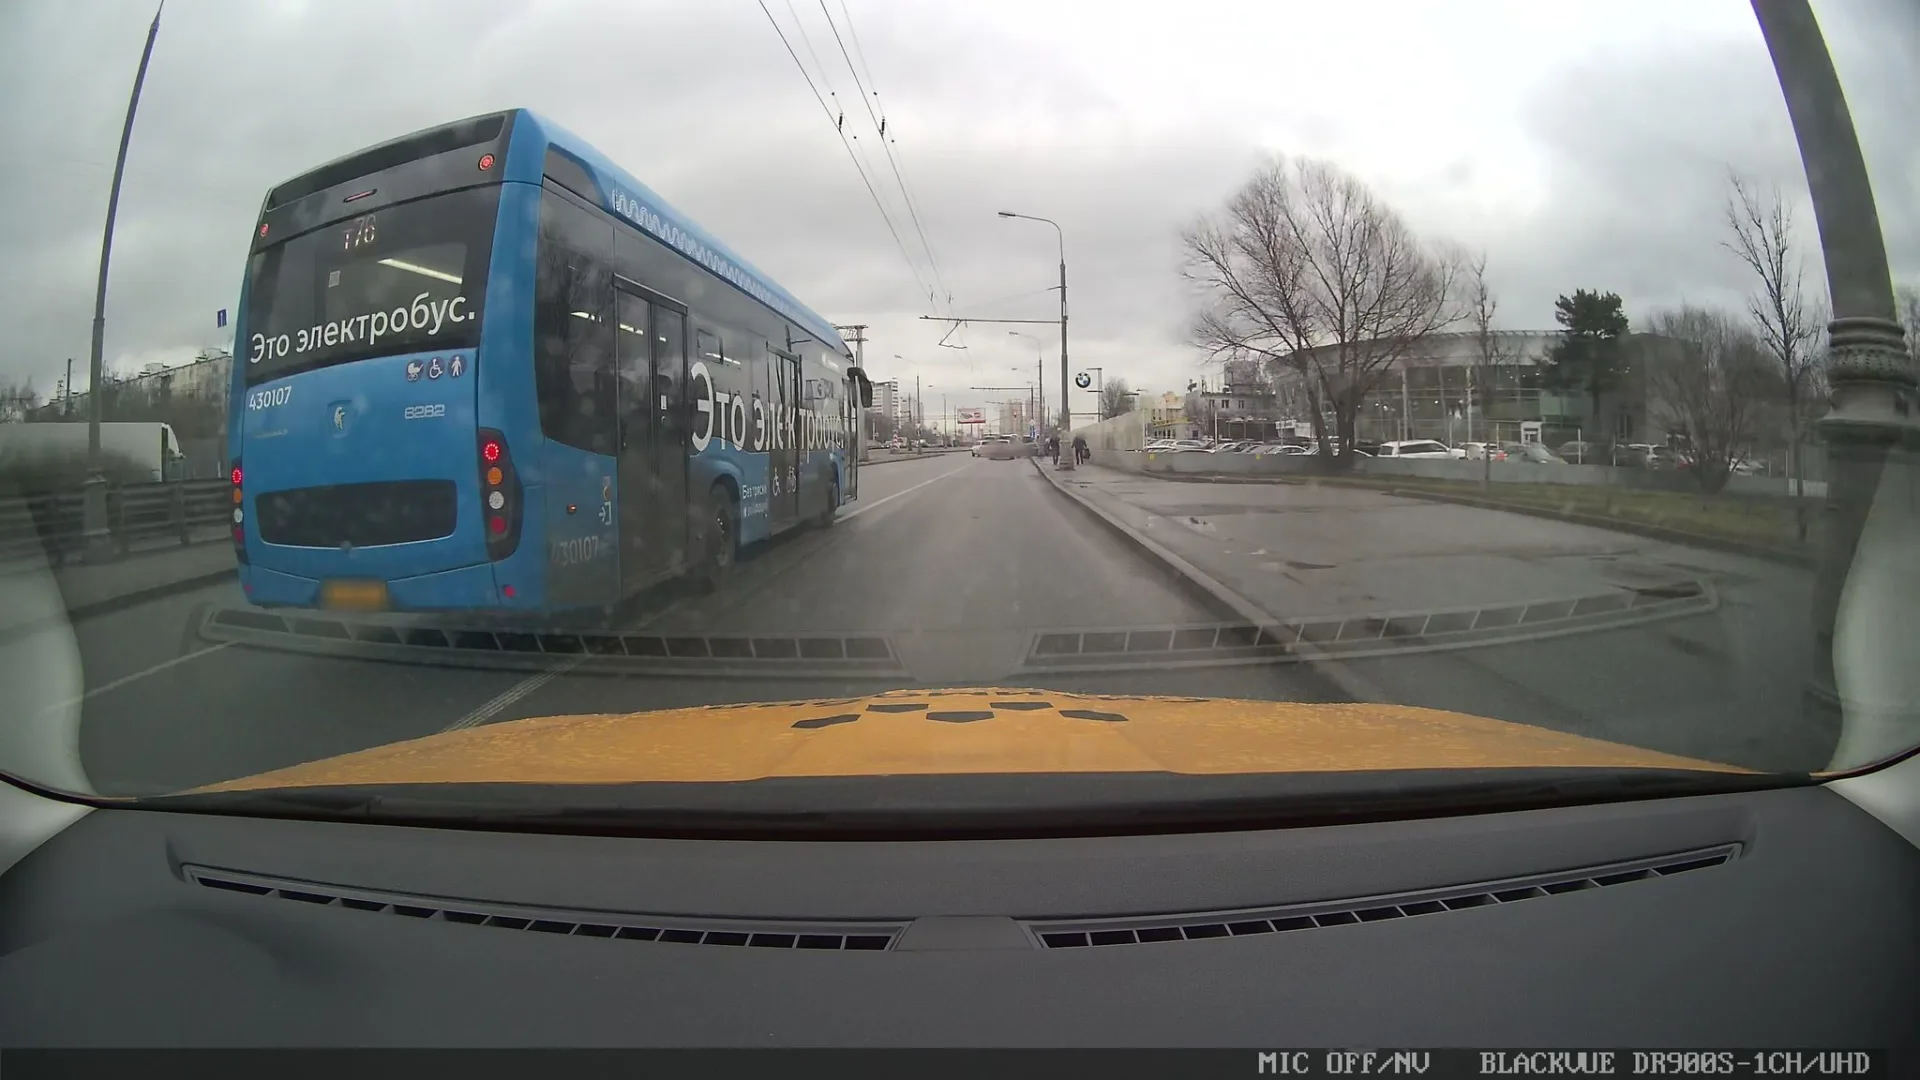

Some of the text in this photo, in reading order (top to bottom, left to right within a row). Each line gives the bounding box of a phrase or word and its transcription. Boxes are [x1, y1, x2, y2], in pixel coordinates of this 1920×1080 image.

[250, 292, 476, 364] Это электробус.
[249, 386, 292, 411] 430107
[690, 361, 746, 452] Это
